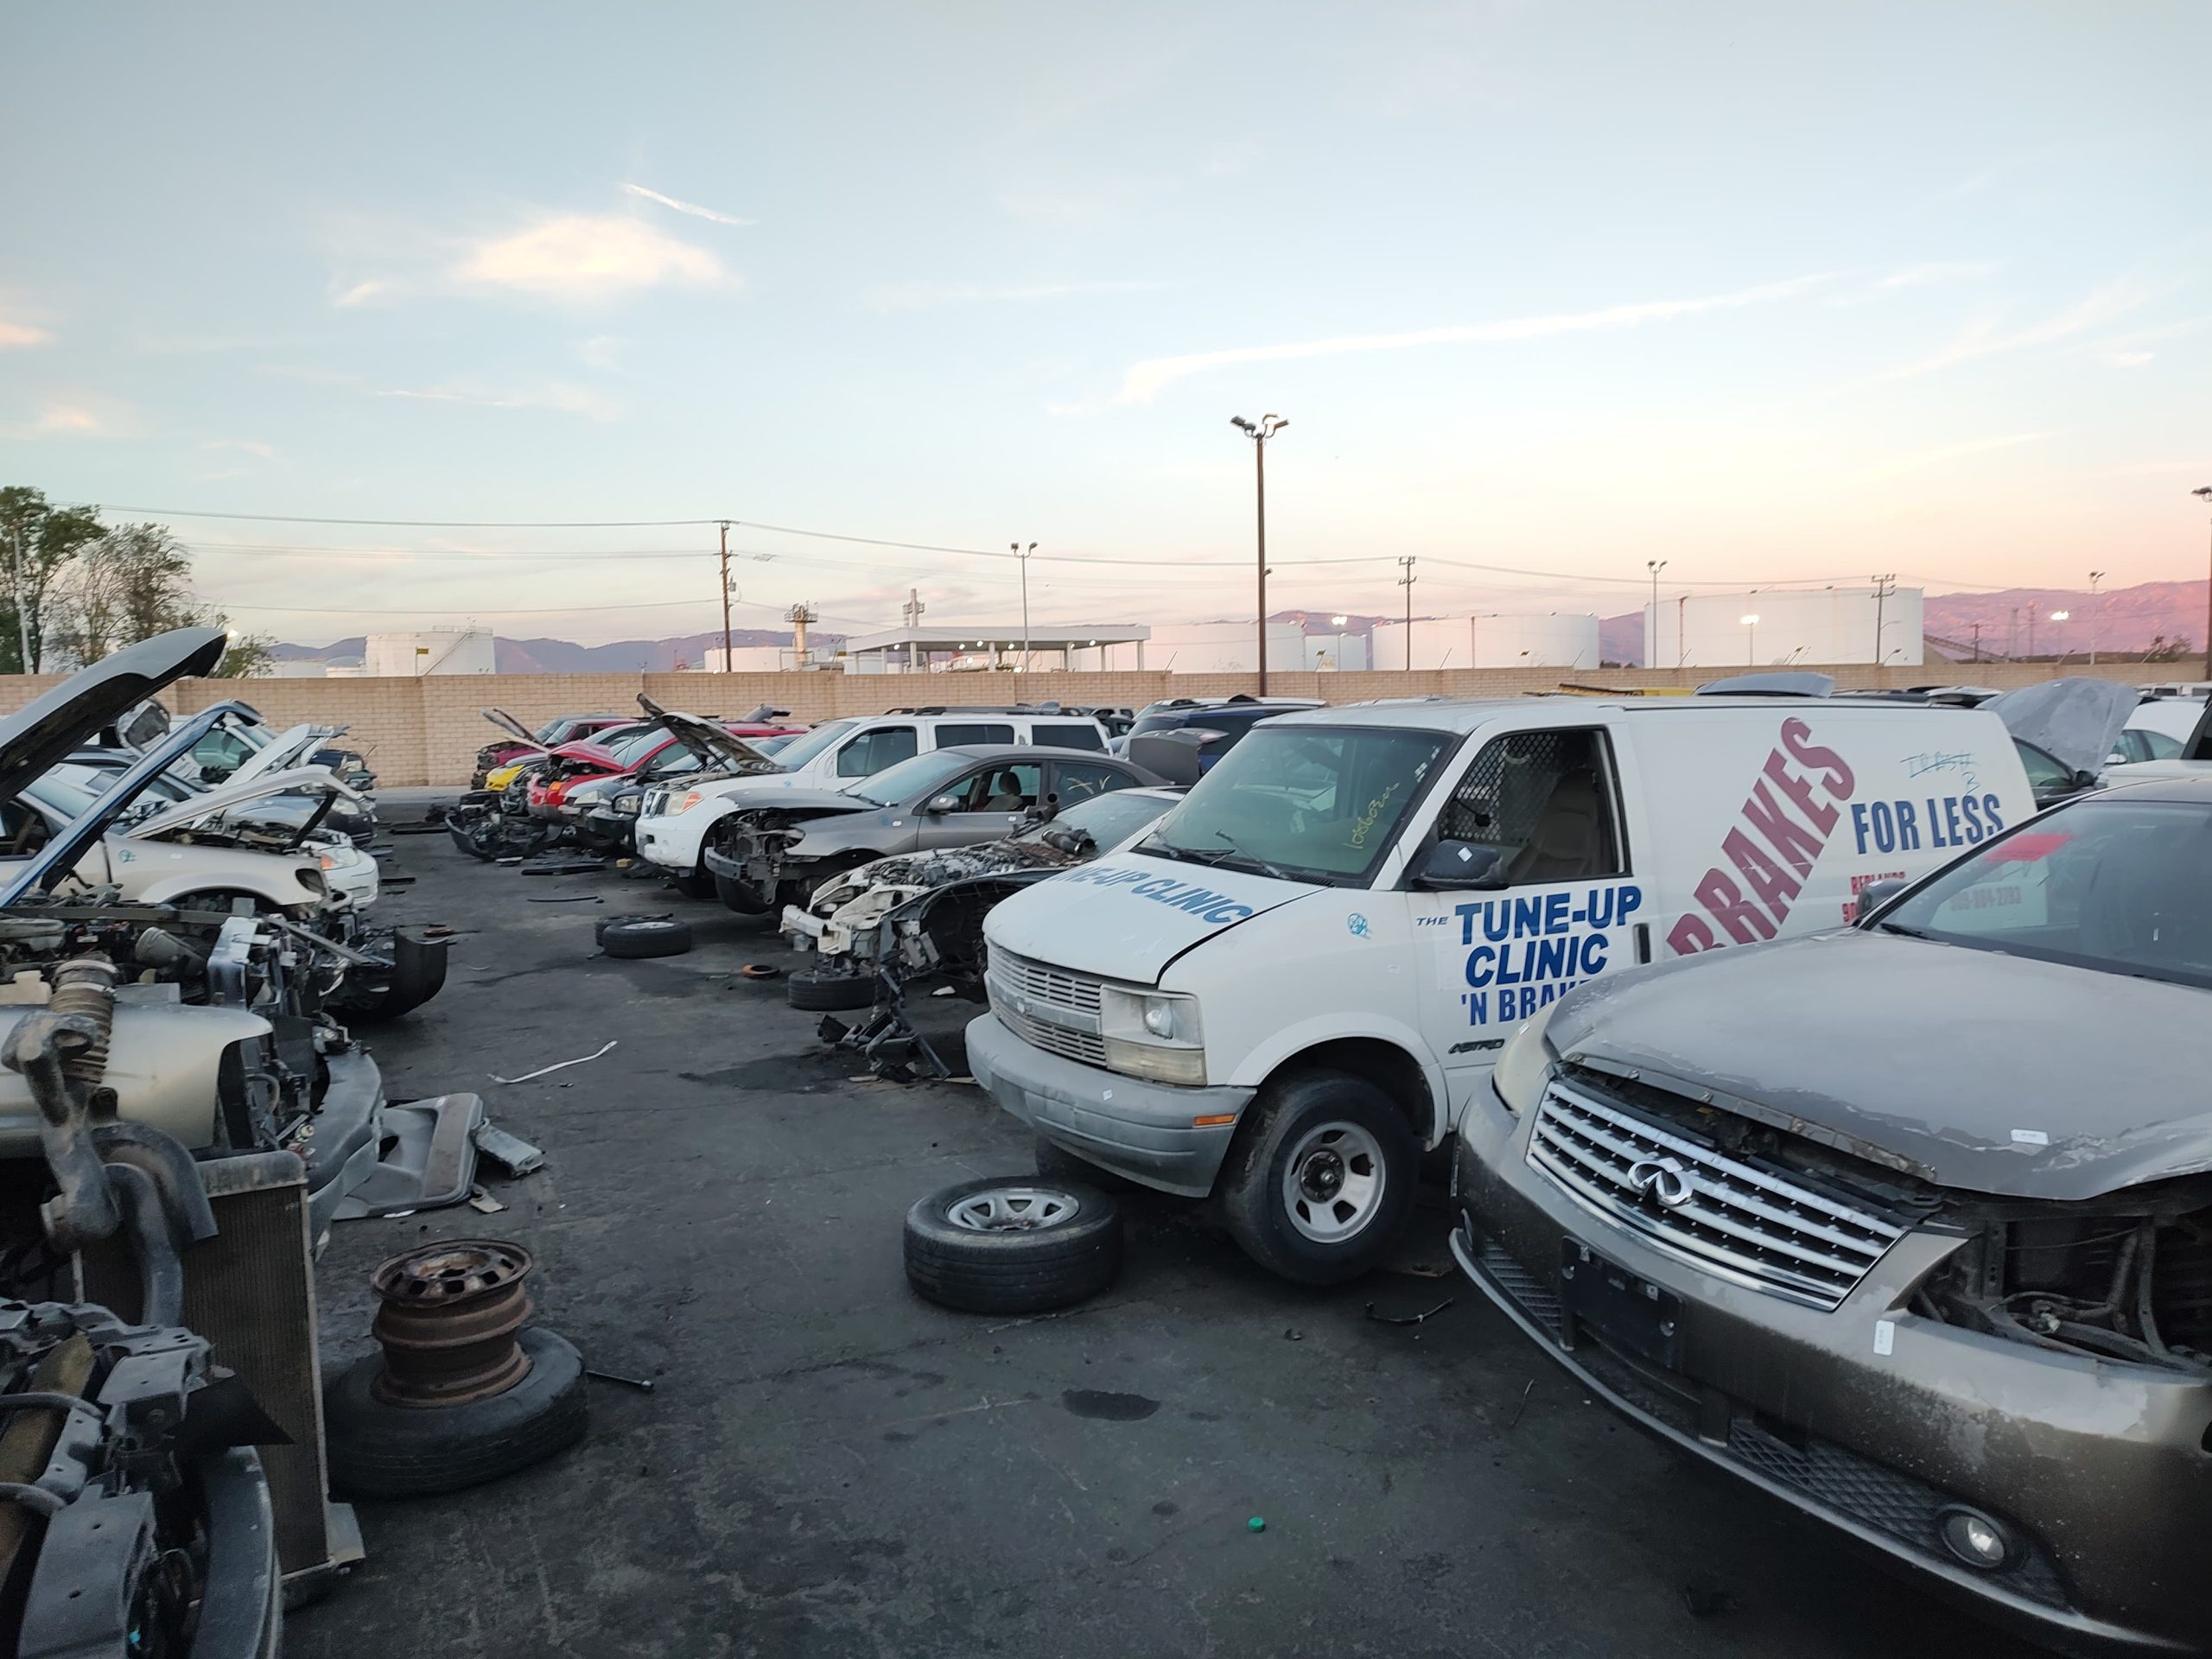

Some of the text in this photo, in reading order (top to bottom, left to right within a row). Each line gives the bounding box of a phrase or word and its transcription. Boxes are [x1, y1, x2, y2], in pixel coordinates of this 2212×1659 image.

[1851, 793, 2004, 855] FOR LESS
[1131, 879, 1254, 924] CLINIC
[1416, 886, 1642, 945] THE TUNE-UP
[1465, 933, 1609, 988] CLINIC
[1448, 1039, 1505, 1054] ASTRO
